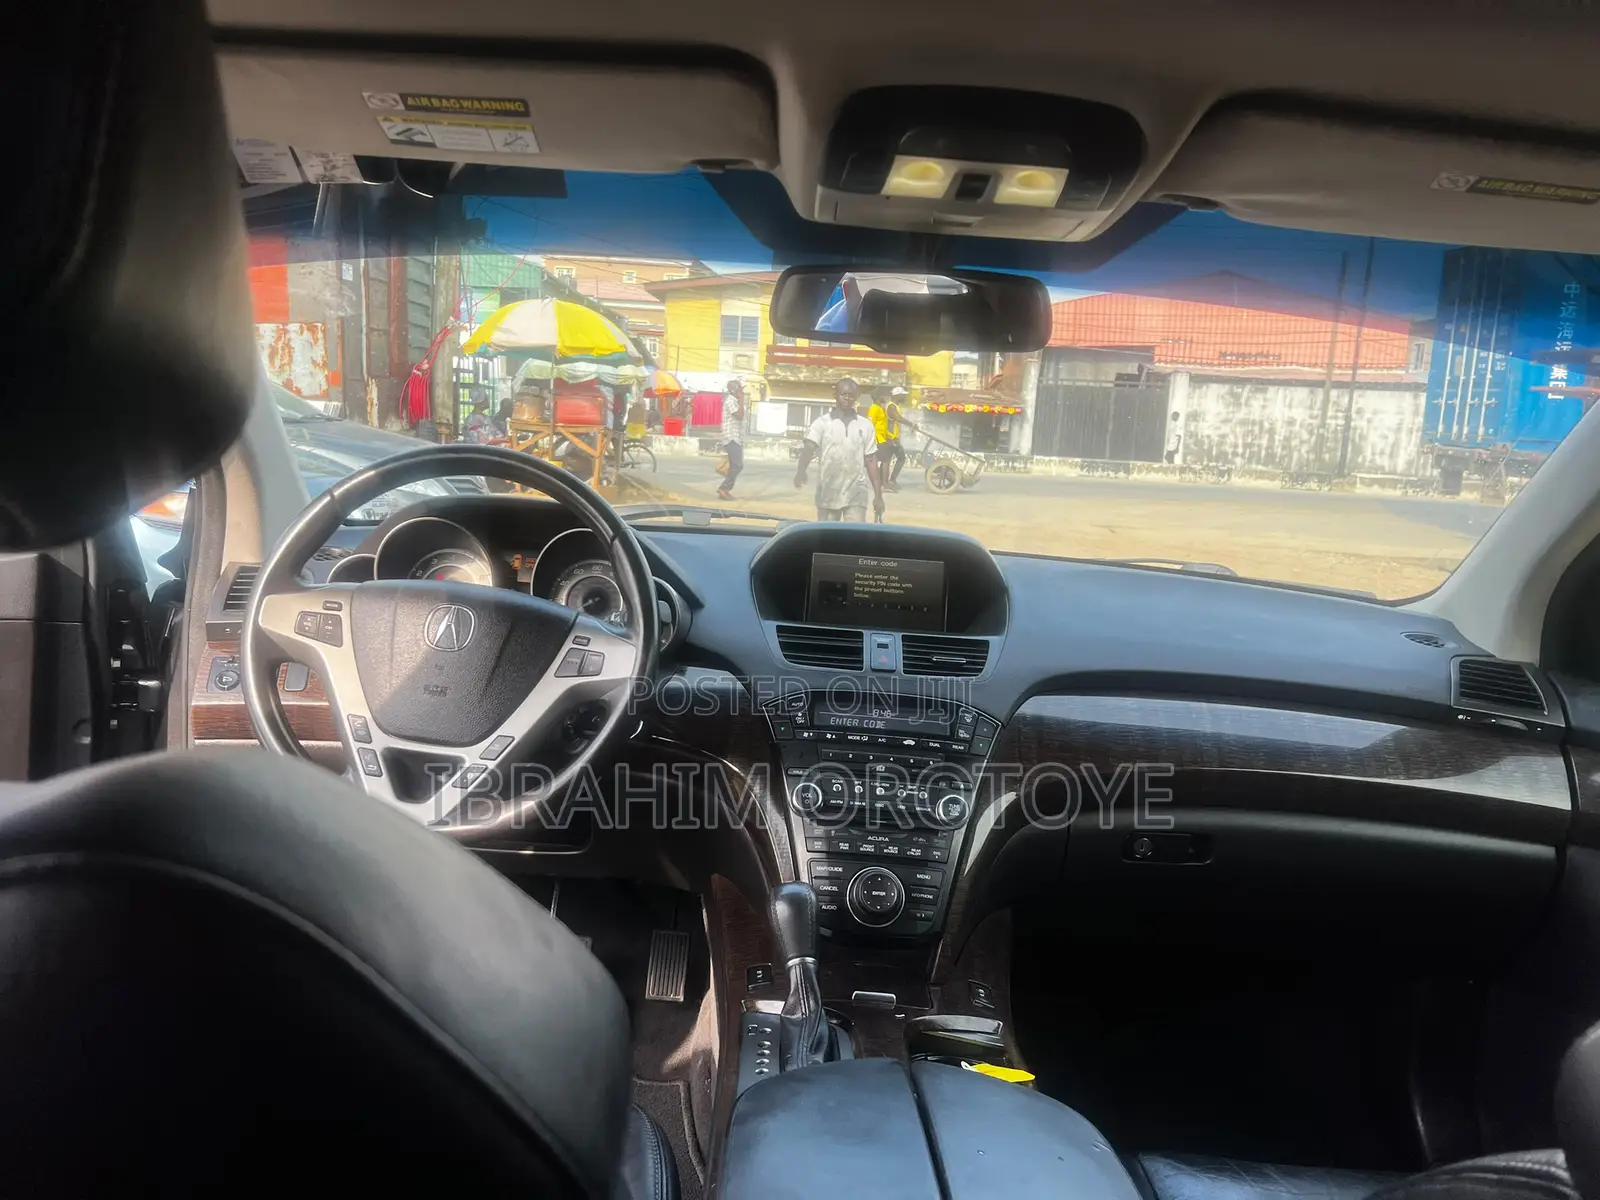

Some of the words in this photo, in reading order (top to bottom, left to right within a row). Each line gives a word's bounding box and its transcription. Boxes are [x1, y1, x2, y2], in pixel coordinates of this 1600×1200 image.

[460, 100, 525, 112] WARNING
[858, 558, 879, 566] Enter
[880, 560, 898, 568] code
[854, 579, 876, 587] security
[830, 716, 860, 727] ENTER
[863, 719, 886, 729] CODE
